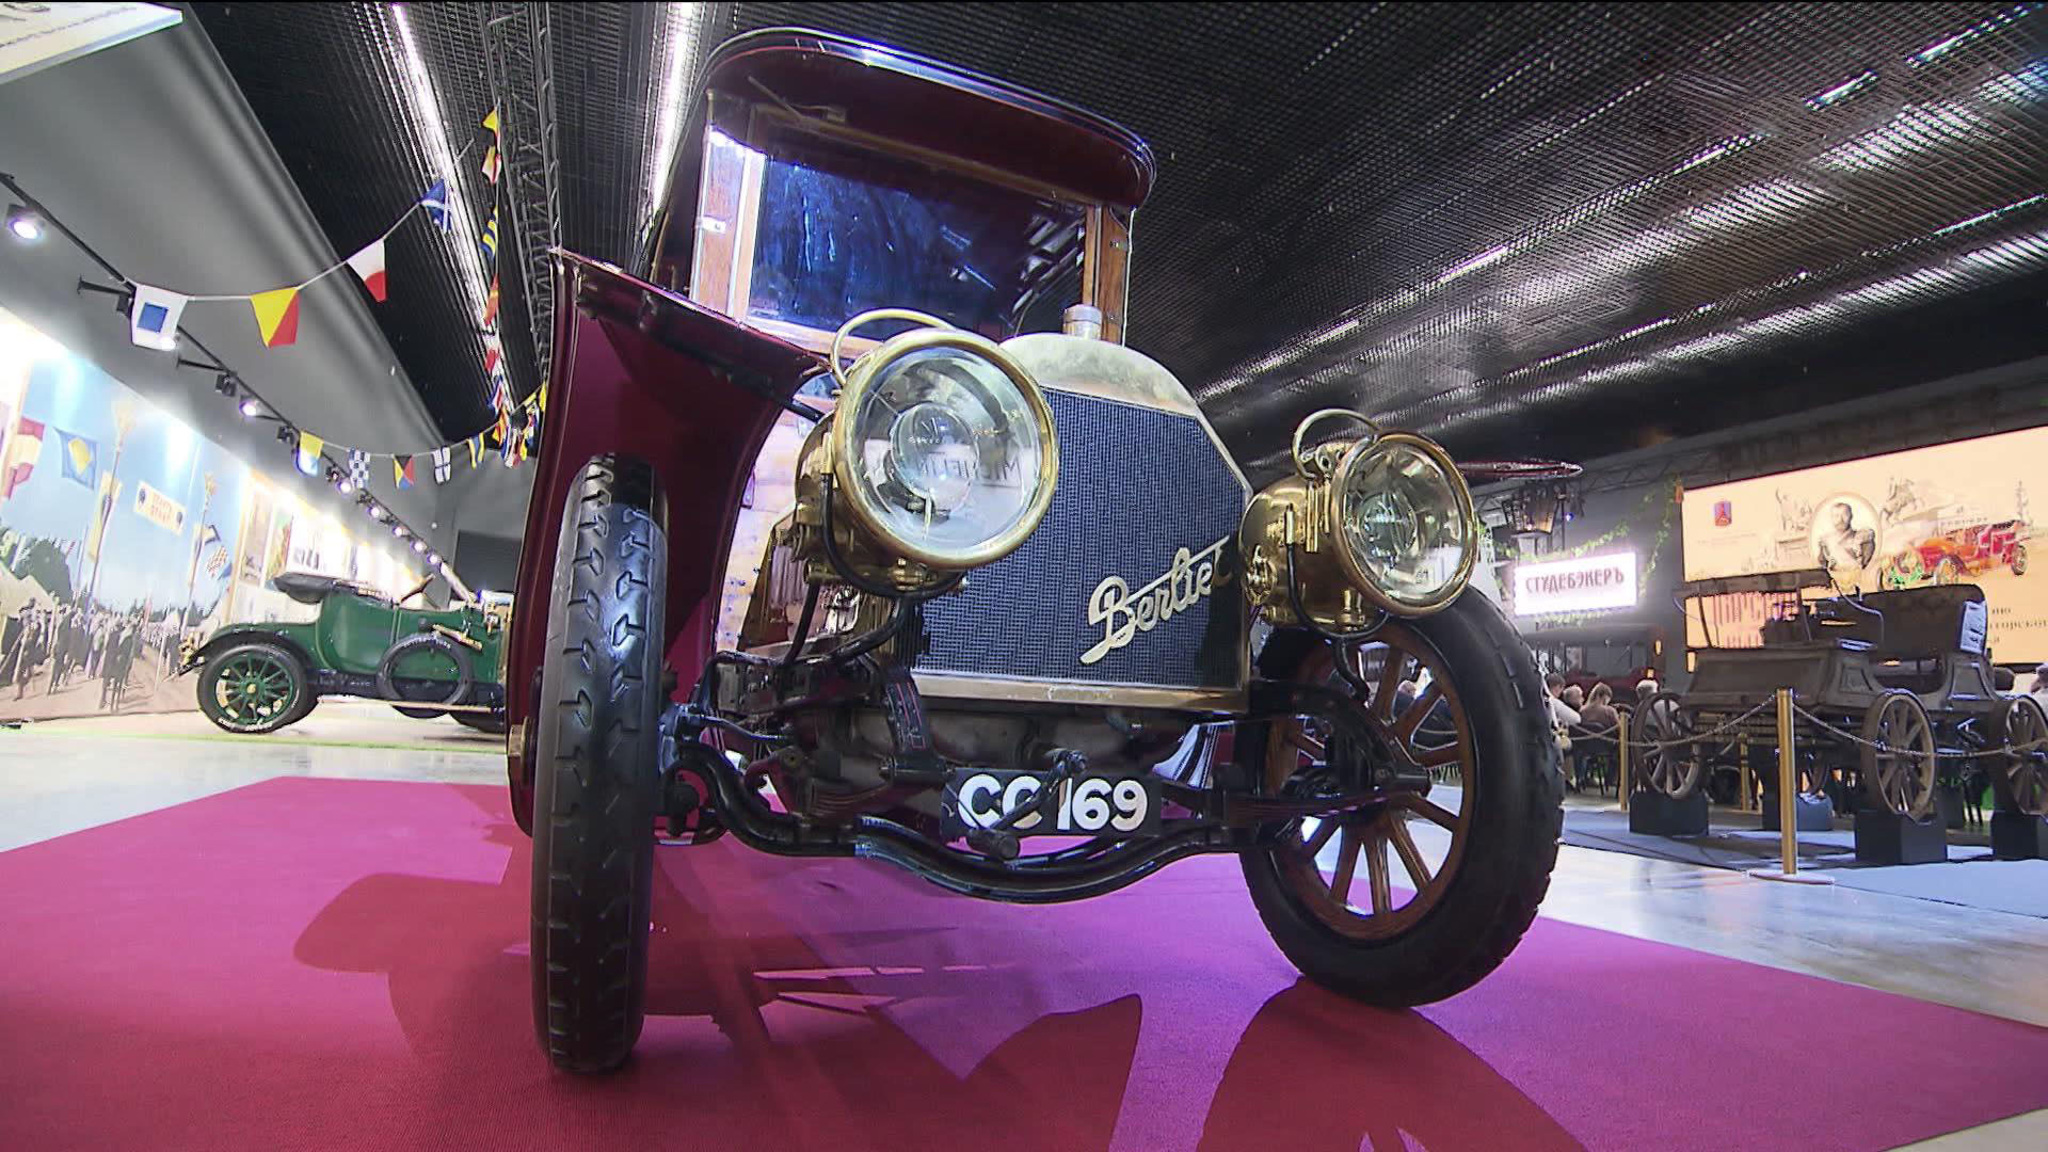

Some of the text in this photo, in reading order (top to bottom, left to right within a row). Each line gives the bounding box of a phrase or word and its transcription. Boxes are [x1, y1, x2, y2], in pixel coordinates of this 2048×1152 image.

[1525, 566, 1625, 594] СТУДЕБЭКЕРЪ
[958, 773, 1149, 832] CC 169
